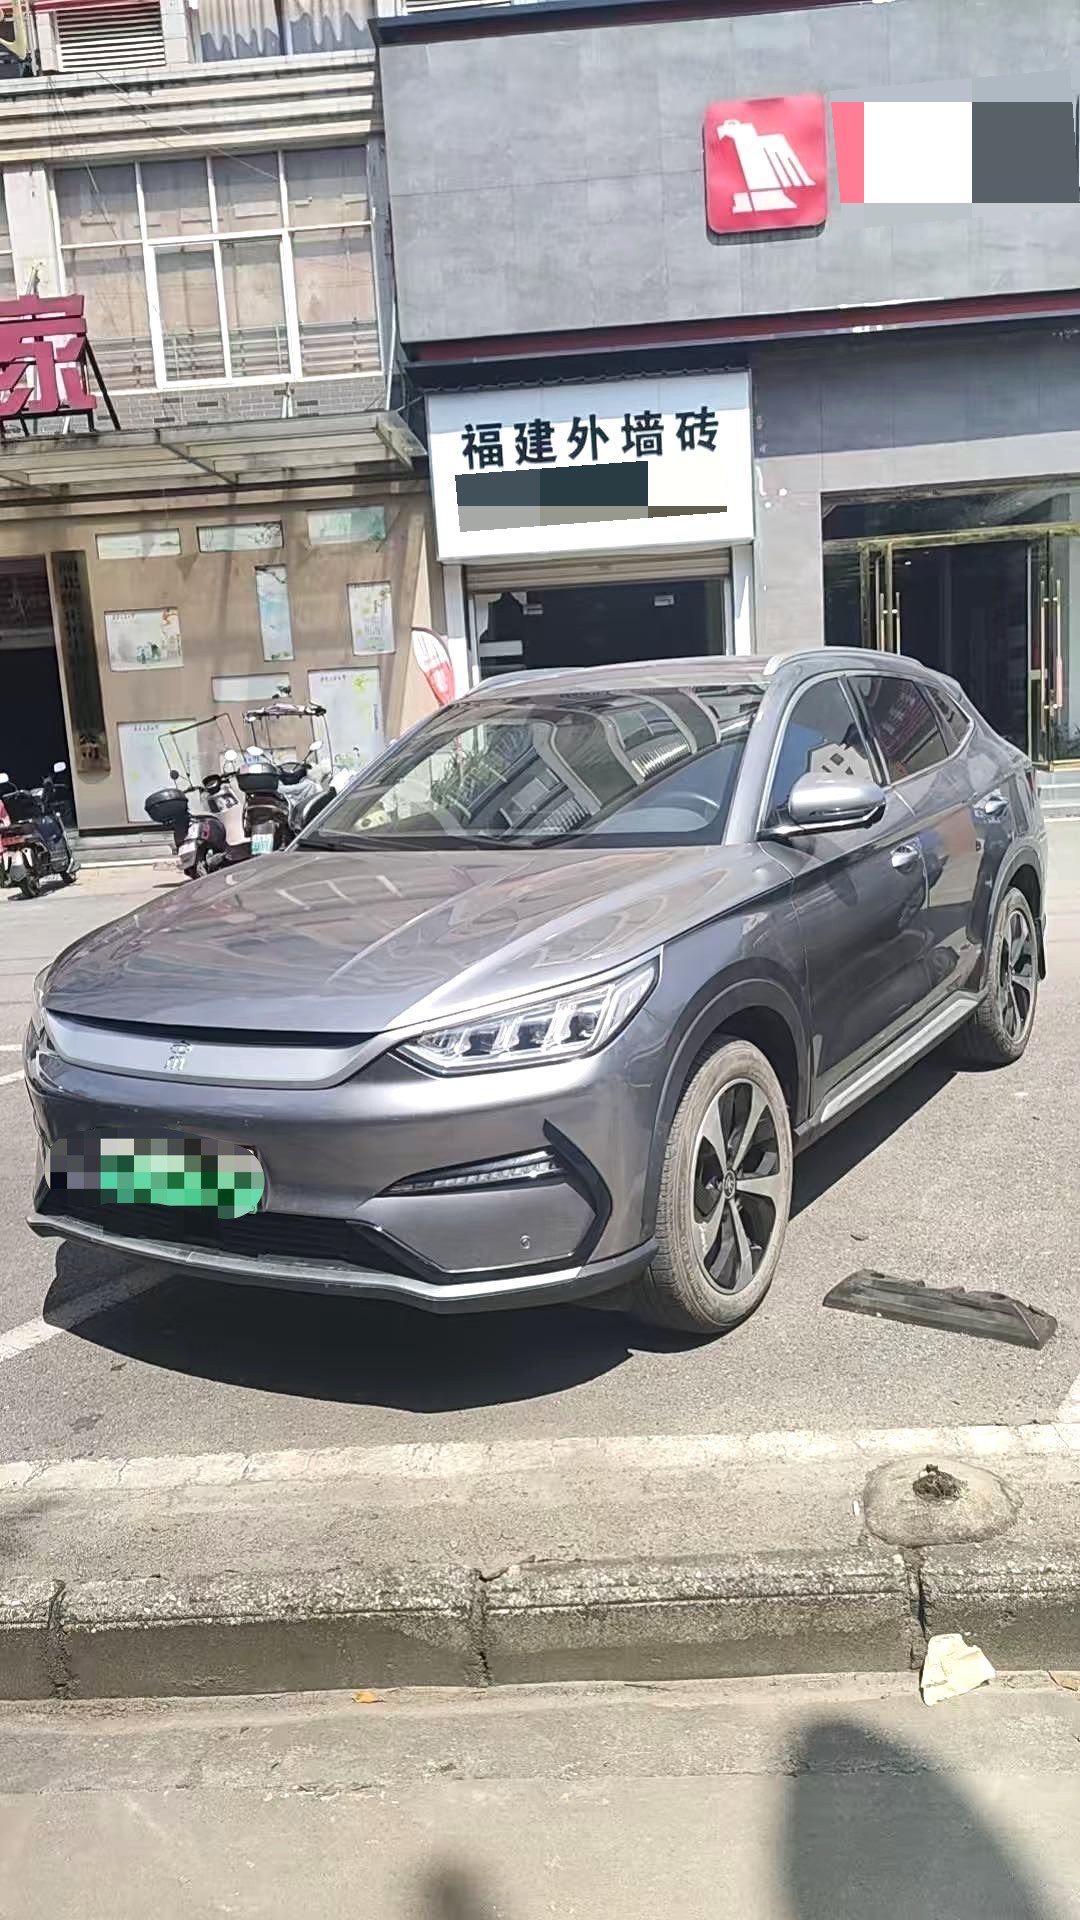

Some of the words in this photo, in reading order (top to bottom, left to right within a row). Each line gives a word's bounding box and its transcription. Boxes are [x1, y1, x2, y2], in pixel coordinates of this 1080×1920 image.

[461, 406, 719, 470] 福建外墙砖
